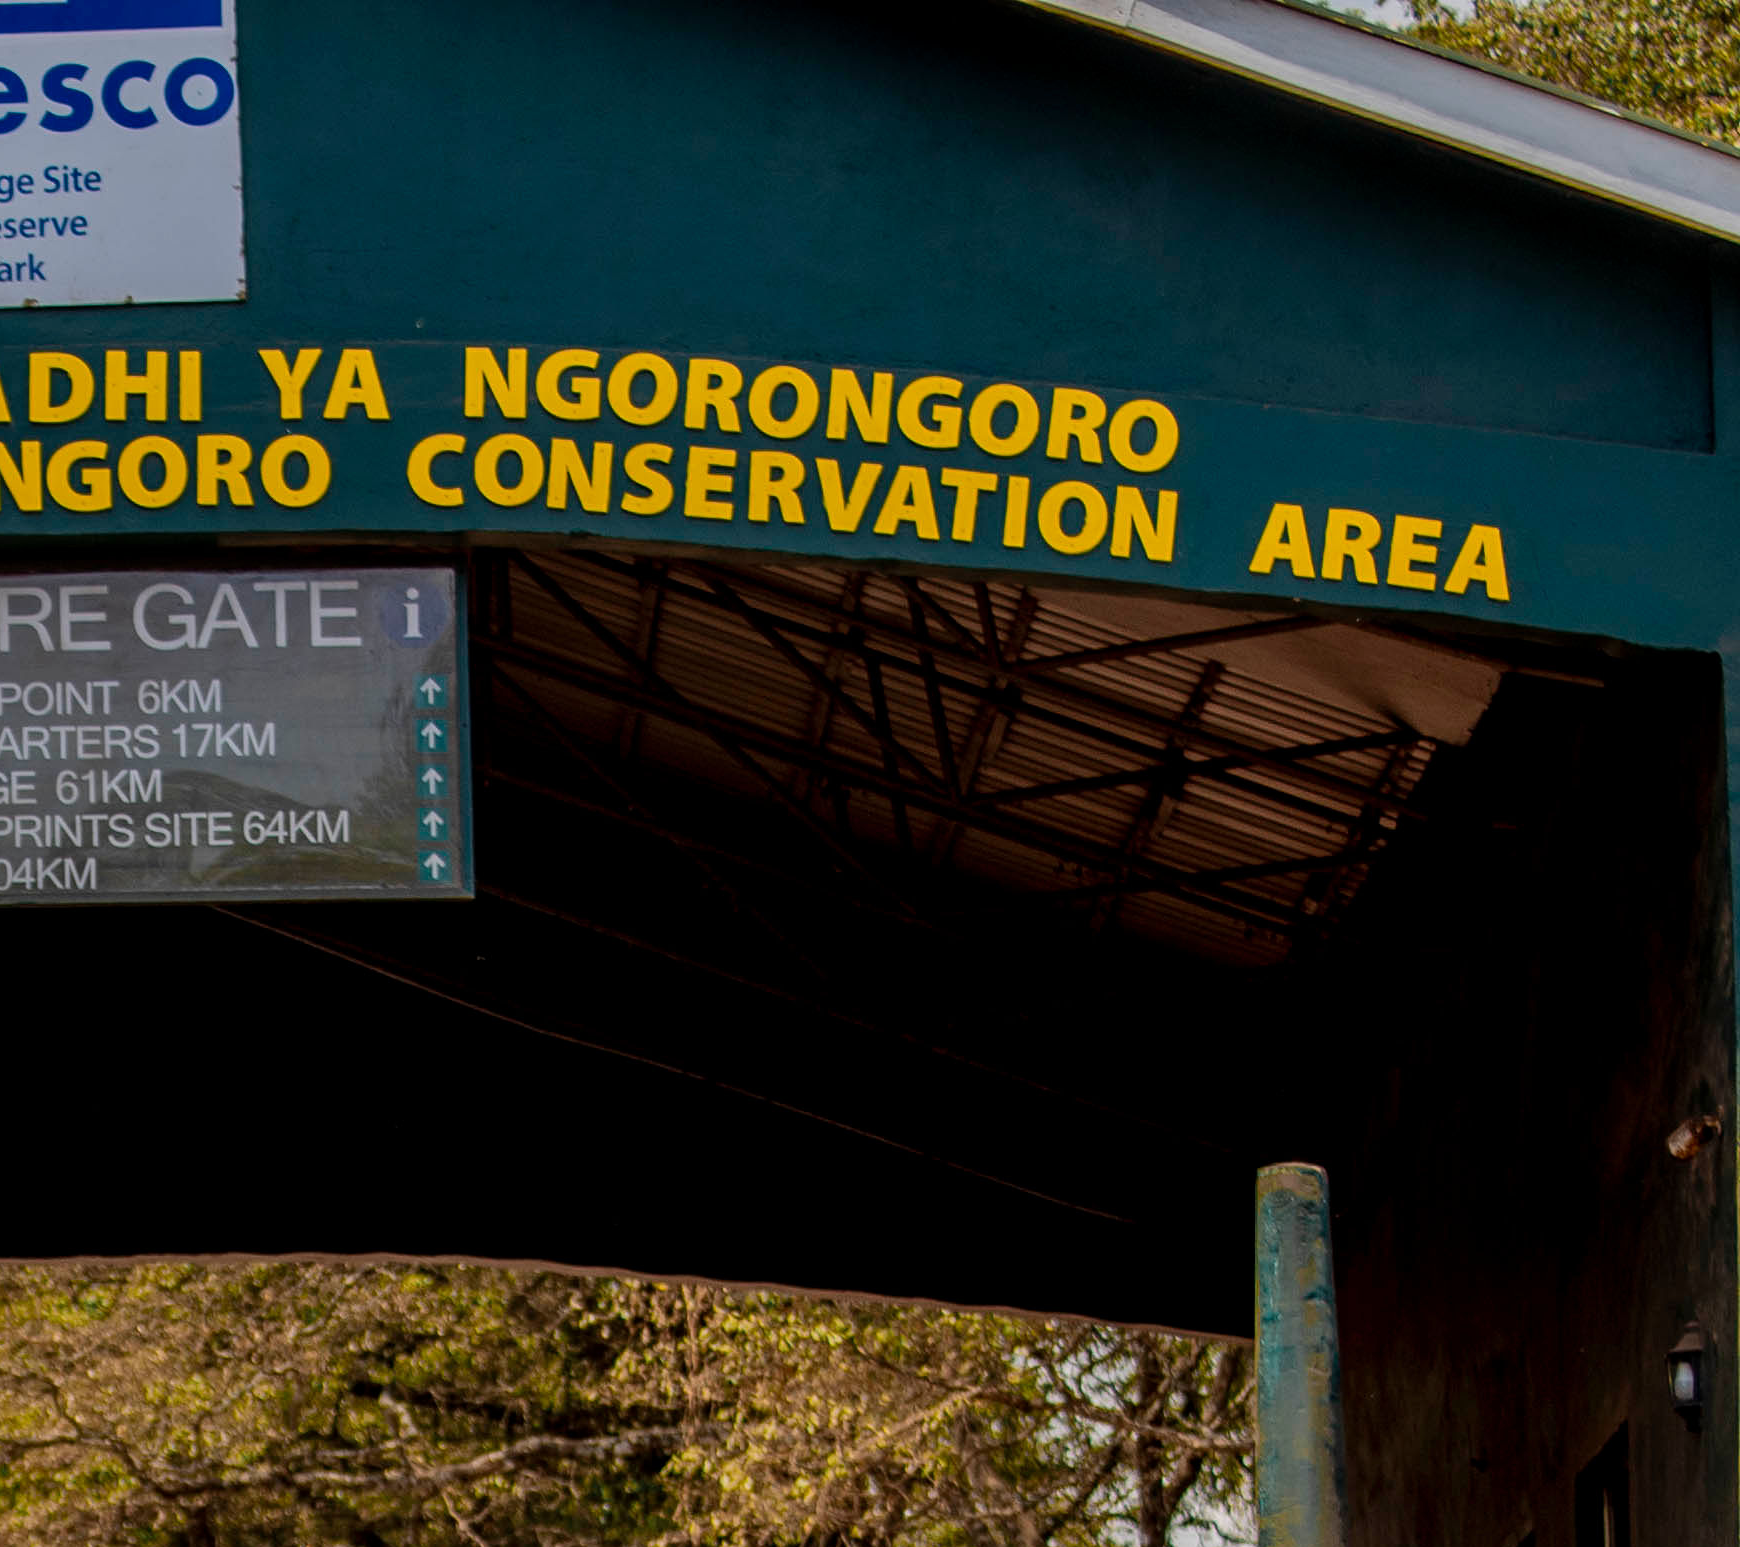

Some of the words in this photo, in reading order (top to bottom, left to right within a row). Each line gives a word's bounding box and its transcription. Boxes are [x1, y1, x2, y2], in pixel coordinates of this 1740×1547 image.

[44, 166, 102, 193] Site
[259, 349, 390, 420] YA
[465, 347, 1179, 473] NGORONGORO
[407, 434, 1179, 562] CONSERVATION
[1249, 504, 1510, 601] AREA
[132, 580, 363, 651] GATE
[138, 680, 222, 714] 6KM
[172, 722, 277, 757] 17KM
[56, 769, 163, 805] 61KM
[144, 811, 235, 847] SITE
[243, 809, 351, 845] 64KM
